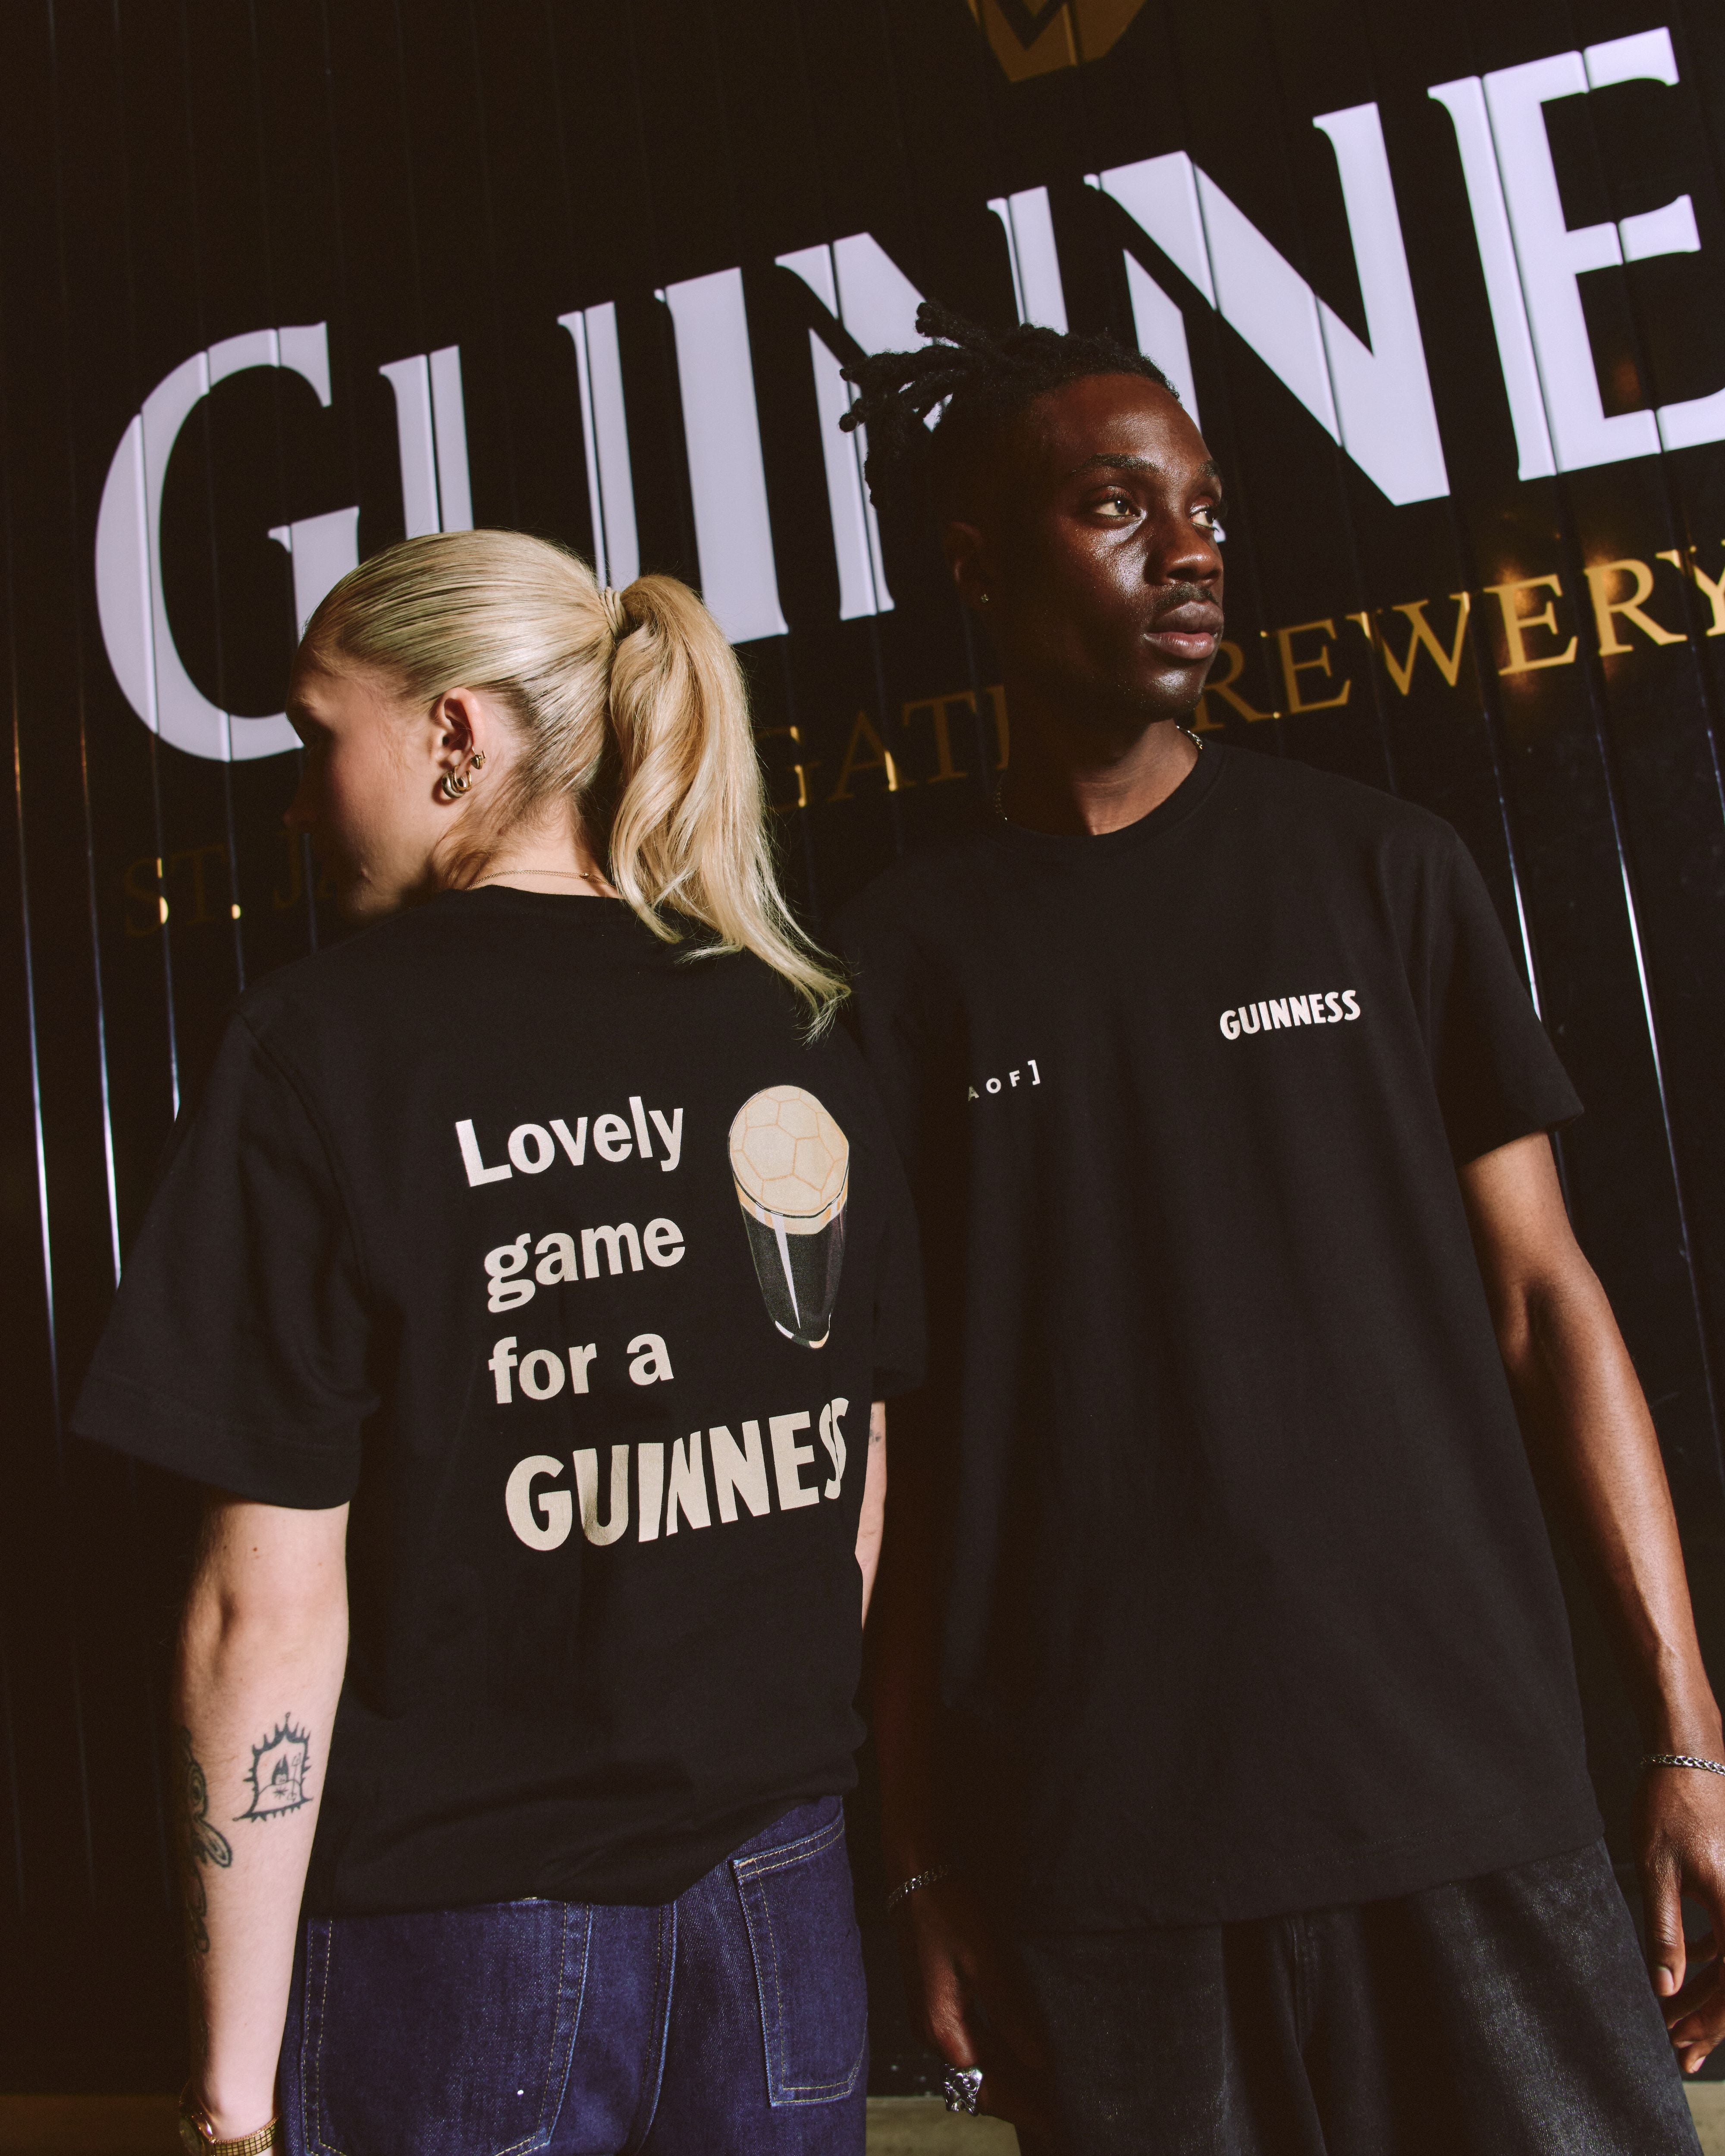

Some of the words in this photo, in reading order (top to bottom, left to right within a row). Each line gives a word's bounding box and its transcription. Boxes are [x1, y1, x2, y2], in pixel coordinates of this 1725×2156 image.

[1189, 538, 1725, 733] REWERY
[1220, 990, 1361, 1040] GUINNESS
[968, 1059, 1041, 1101] AOF]
[455, 1096, 683, 1187] Lovely
[484, 1218, 685, 1313] game
[488, 1336, 597, 1404] for
[627, 1333, 674, 1385] a
